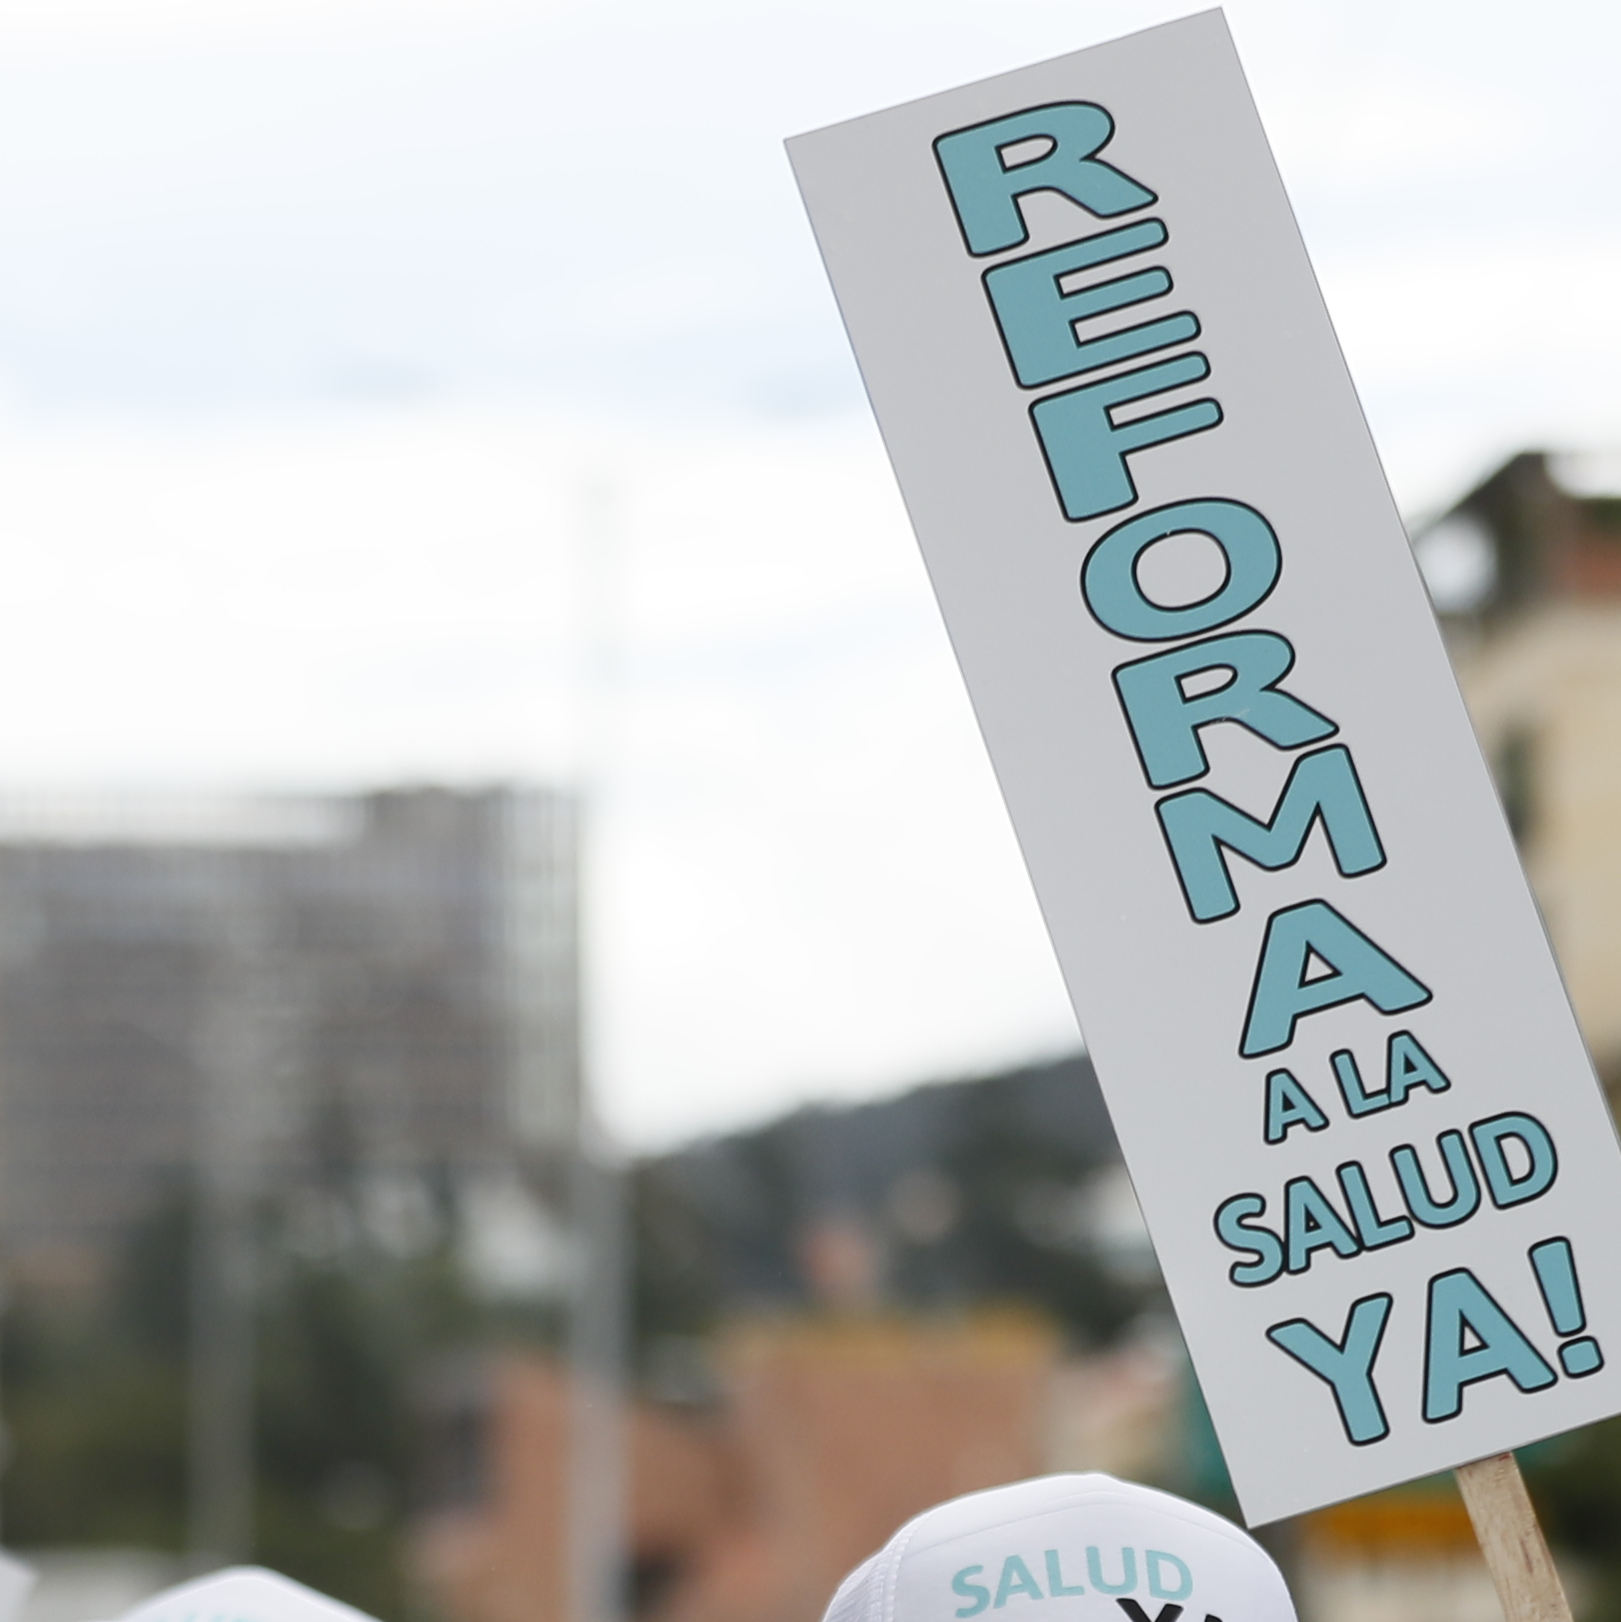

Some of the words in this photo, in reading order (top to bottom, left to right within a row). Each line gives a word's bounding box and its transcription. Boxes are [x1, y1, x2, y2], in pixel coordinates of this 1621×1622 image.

[932, 99, 1433, 1059] REFORMA
[1263, 1068, 1330, 1145] A
[1328, 1030, 1450, 1120] LA
[1213, 1111, 1559, 1288] SALUD
[1265, 1236, 1605, 1447] YA!
[950, 1544, 1195, 1619] SALUD
